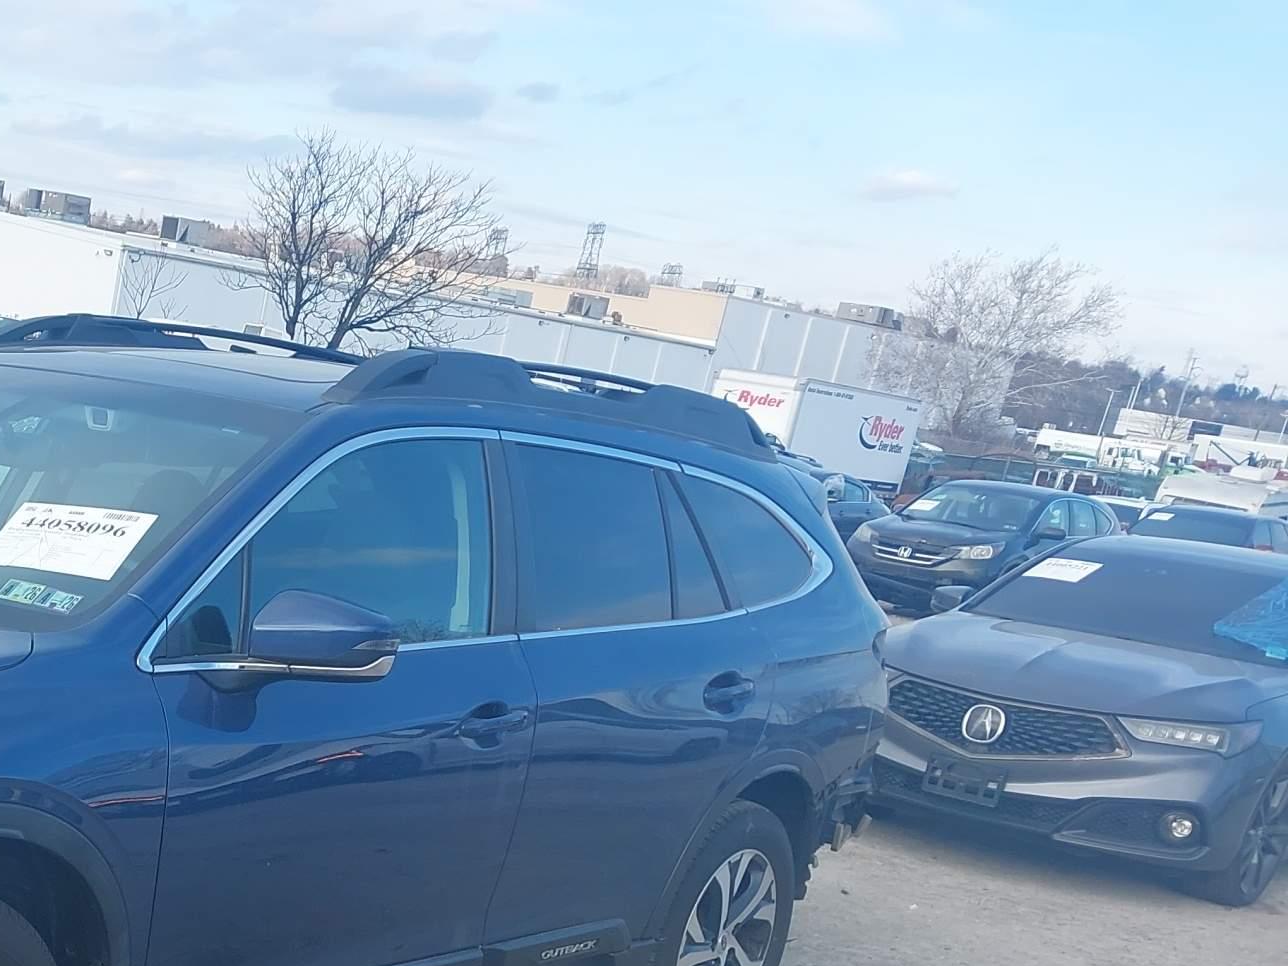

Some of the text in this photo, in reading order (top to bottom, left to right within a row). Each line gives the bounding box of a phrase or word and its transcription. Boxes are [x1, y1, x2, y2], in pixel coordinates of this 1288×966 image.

[737, 389, 785, 408] Ryder
[869, 415, 905, 442] Ryder
[21, 516, 128, 538] 44058096
[540, 939, 597, 960] OUTBACK
